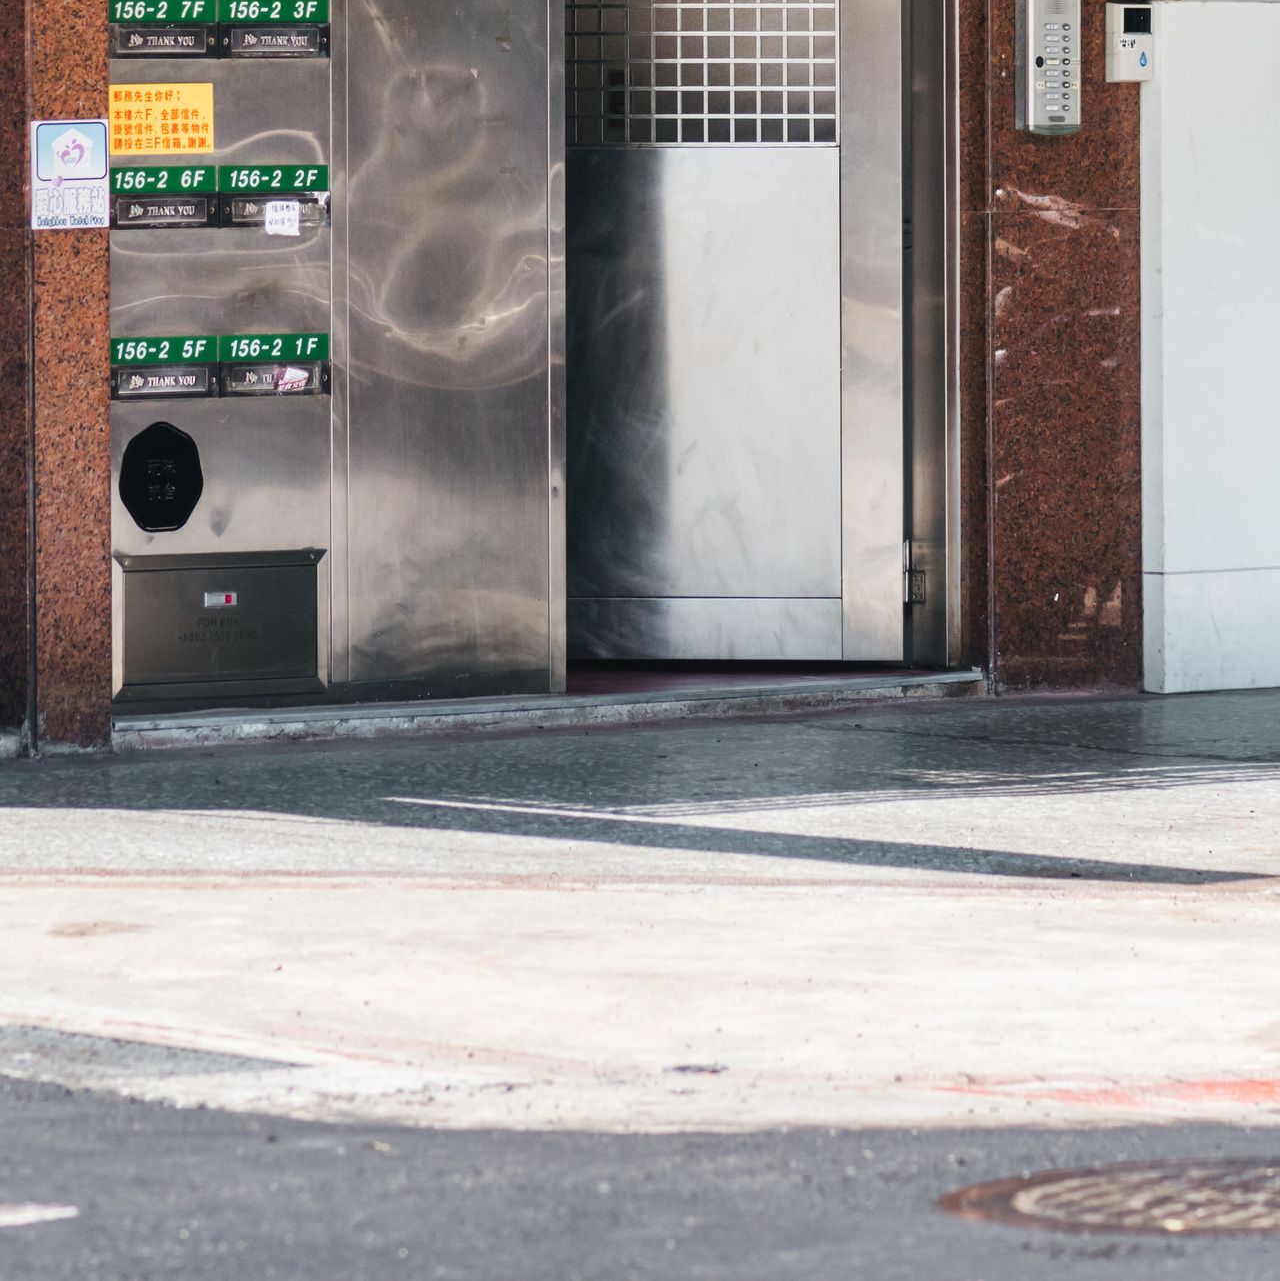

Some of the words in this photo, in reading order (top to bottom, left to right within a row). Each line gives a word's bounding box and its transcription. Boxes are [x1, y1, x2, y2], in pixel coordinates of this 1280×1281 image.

[114, 1, 168, 19] 156-2
[180, 1, 205, 19] 7F
[228, 1, 282, 19] 156-2
[293, 0, 318, 19] 3F
[146, 35, 173, 47] THANK
[174, 34, 195, 47] YOU
[261, 34, 289, 47] THANK
[291, 34, 308, 48] YOU
[115, 170, 168, 189] 156-2
[180, 169, 206, 188] 6F
[230, 169, 282, 188] 156-2
[294, 169, 318, 187] 2F
[147, 205, 175, 216] THANK
[178, 205, 195, 216] YOU
[116, 340, 169, 360] 156-2
[181, 339, 207, 359] 5F
[230, 338, 283, 358] 156-2
[296, 337, 318, 355] 1F
[147, 375, 175, 387] THANK
[178, 374, 196, 386] YOU
